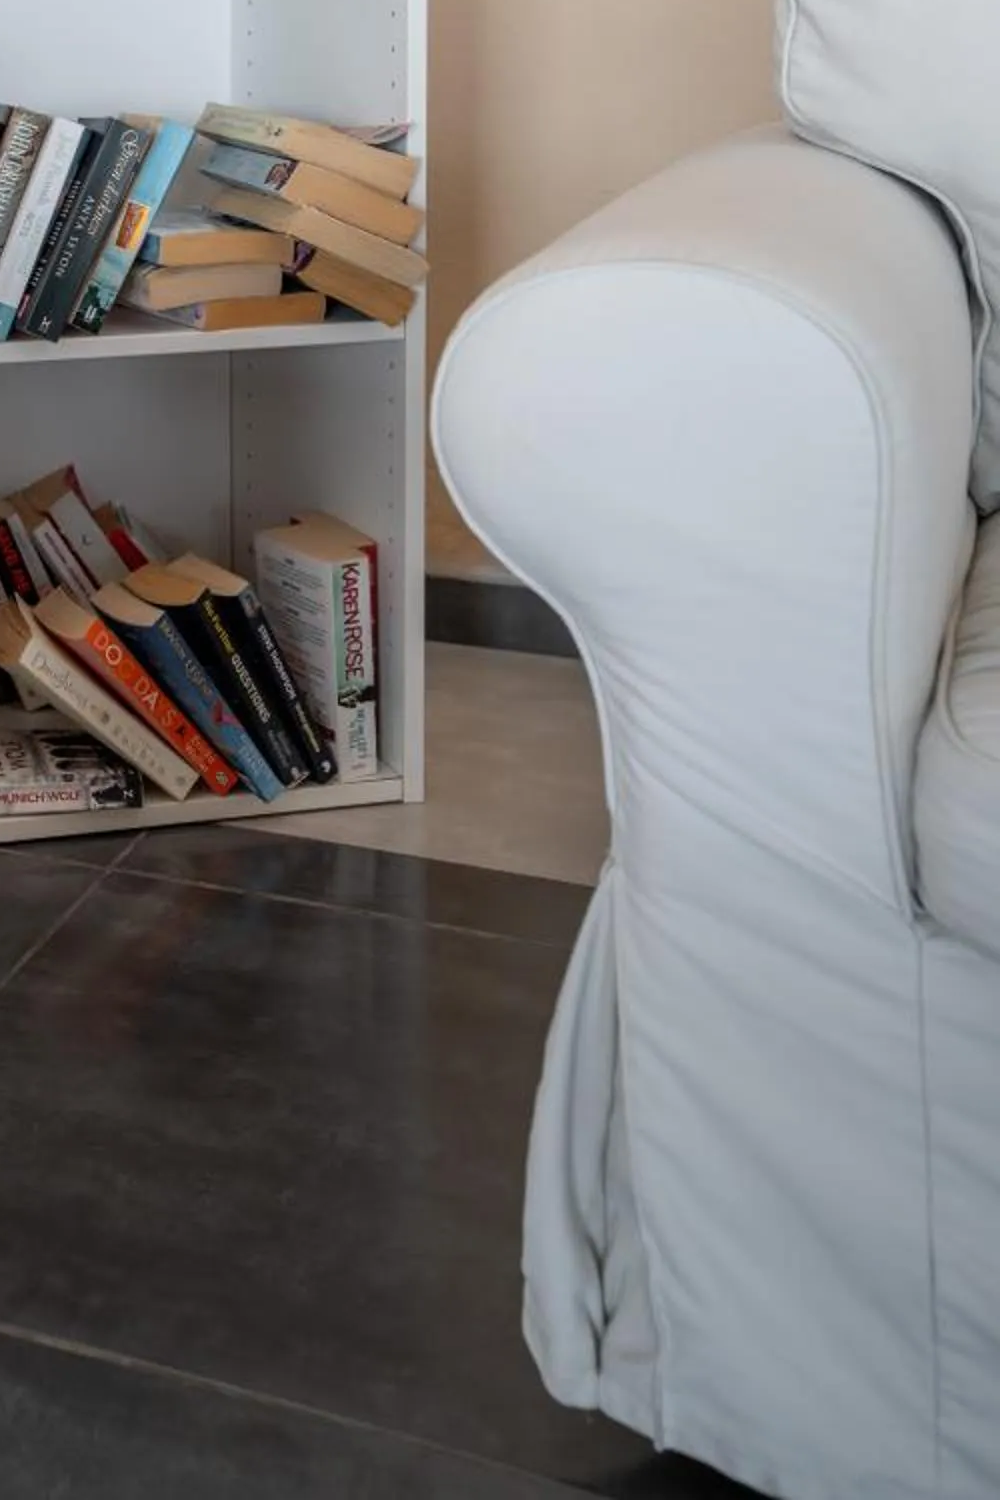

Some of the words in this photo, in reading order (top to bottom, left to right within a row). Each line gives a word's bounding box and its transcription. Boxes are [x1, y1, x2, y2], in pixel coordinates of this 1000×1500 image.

[11, 120, 36, 160] JOHN
[75, 194, 96, 231] ANYA
[88, 178, 119, 238] darkness
[55, 235, 79, 279] SETON
[342, 562, 361, 624] KAREN
[344, 624, 365, 681] ROSE
[231, 654, 271, 724] QUESTIONS
[46, 786, 81, 802] WOLF
